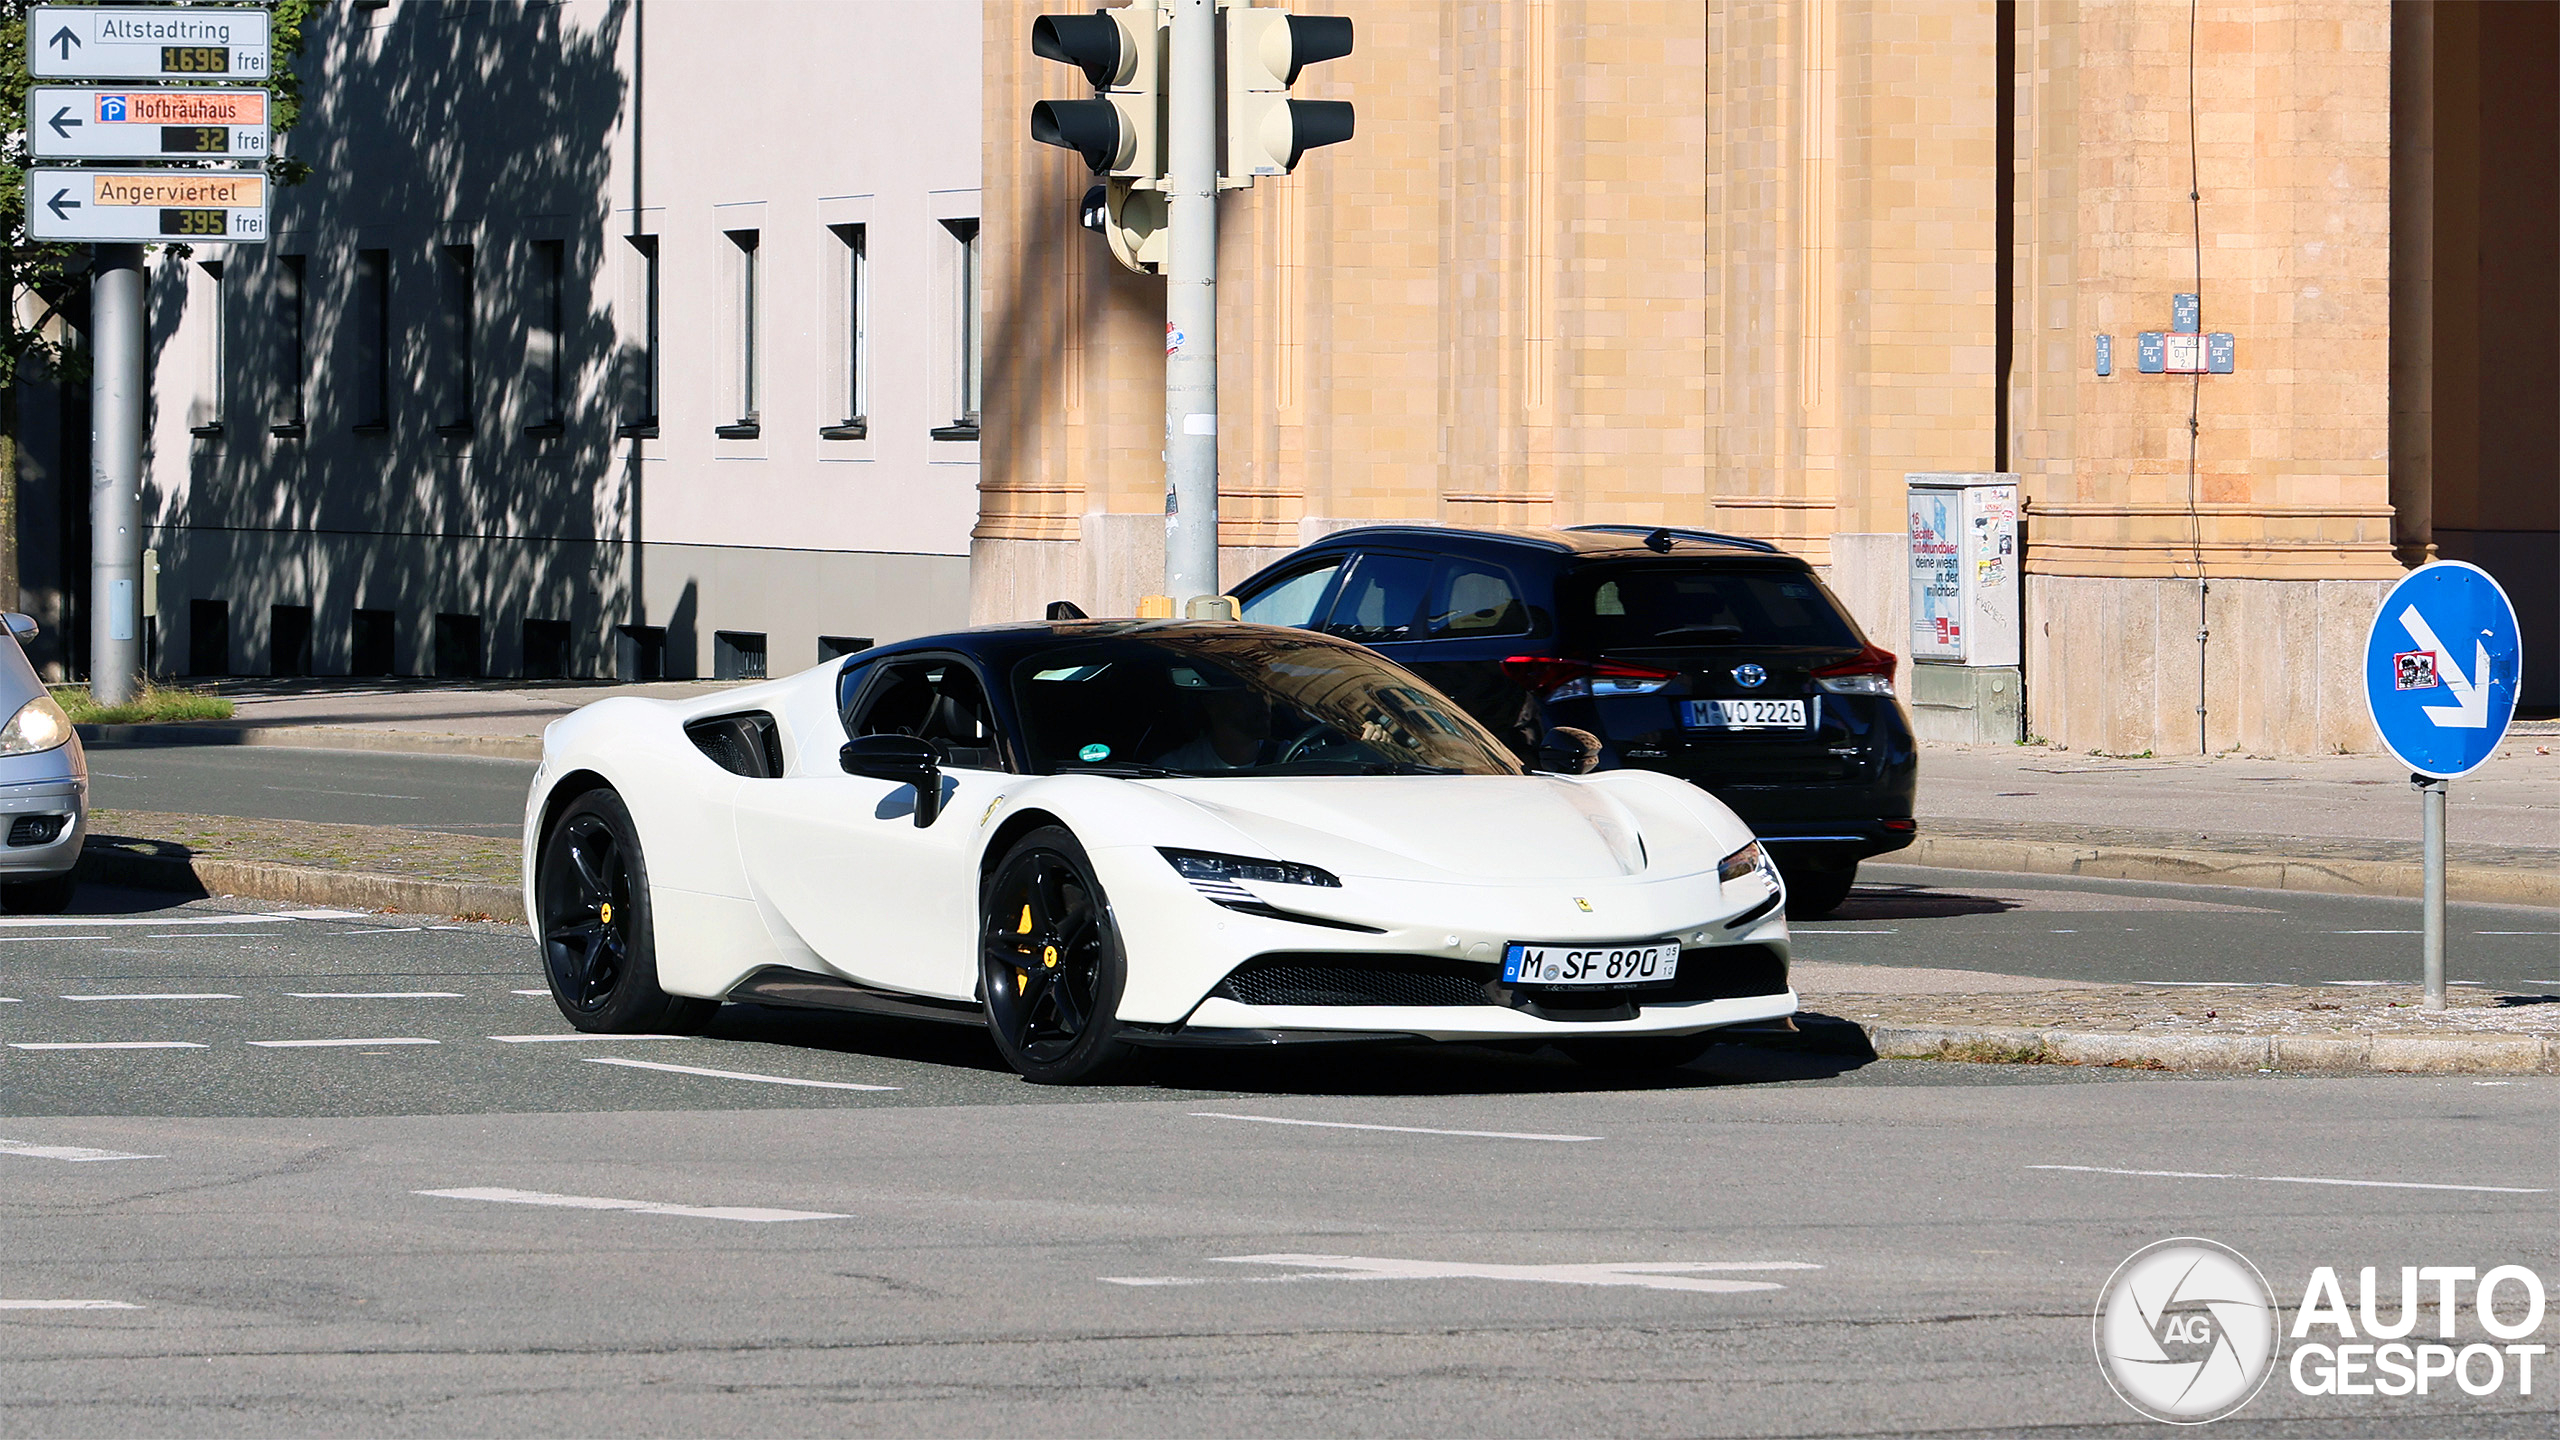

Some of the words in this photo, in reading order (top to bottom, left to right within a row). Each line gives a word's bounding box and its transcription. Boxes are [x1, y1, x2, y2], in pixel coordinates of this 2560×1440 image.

[103, 19, 230, 44] Altstadtring
[165, 48, 225, 72] 1696
[237, 52, 264, 71] frei
[135, 99, 236, 119] Hofbräuhaus
[195, 128, 225, 152] 32
[237, 132, 264, 150] frei
[100, 182, 237, 204] Angerviertel
[179, 210, 224, 234] 395
[236, 214, 263, 233] frei
[1912, 512, 1920, 526] 16
[1915, 555, 1935, 568] deine
[1936, 556, 1958, 569] wiesn
[1936, 570, 1943, 583] in
[1944, 570, 1958, 583] der
[1693, 703, 1709, 725] M
[1722, 702, 1749, 723] VO
[1754, 702, 1801, 723] 2226
[1665, 946, 1678, 957] 05
[1506, 966, 1516, 976] D
[1521, 949, 1545, 978] M
[1562, 950, 1603, 979] SF
[1605, 948, 1659, 979] 890
[1663, 966, 1674, 976] 10
